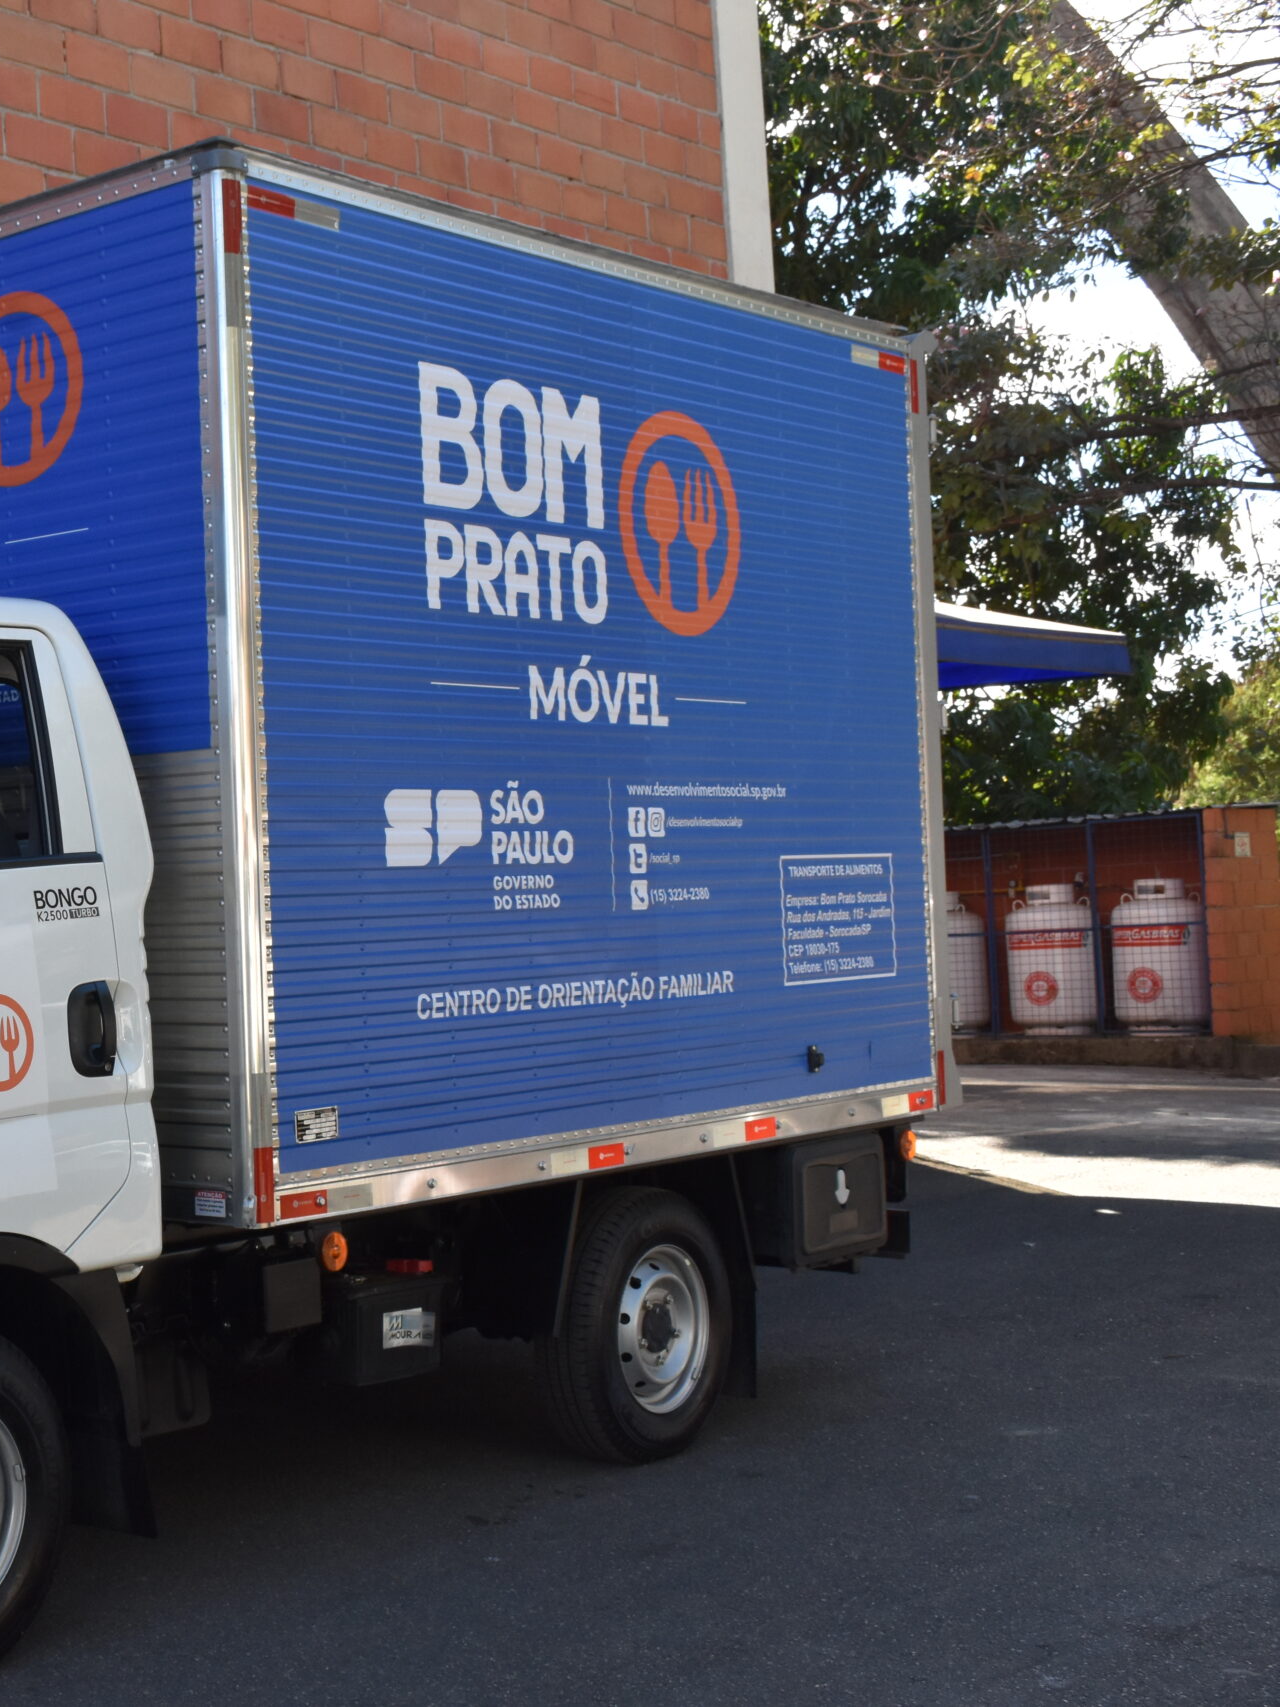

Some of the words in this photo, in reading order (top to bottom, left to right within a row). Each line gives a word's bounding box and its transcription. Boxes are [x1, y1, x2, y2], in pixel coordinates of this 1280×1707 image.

[418, 361, 604, 529] BOM
[424, 518, 608, 625] PRATO
[527, 654, 669, 727] MÓVEL
[626, 781, 787, 800] www.desenvolvimentosocial.sp.gov.br
[489, 780, 545, 826] SÃO
[491, 830, 574, 866] PAULO
[649, 852, 681, 865] /social_sp
[788, 865, 835, 878] TRANSPORTE
[835, 865, 845, 876] DE
[845, 864, 883, 875] ALIMENTOS
[492, 874, 554, 891] GOVERNO
[33, 886, 97, 910] BONGO
[494, 894, 512, 911] DO
[515, 893, 561, 910] ESTADO
[650, 888, 667, 904] (15)
[669, 888, 710, 901] 3224-2380
[786, 894, 819, 909] Empresa:
[820, 893, 837, 905] Bom
[838, 892, 856, 904] Prato
[37, 909, 69, 922] K2500
[70, 907, 98, 919] TURBO
[787, 911, 802, 923] Rua
[802, 910, 816, 922] dos
[788, 927, 824, 940] Faculdade
[788, 944, 804, 957] CEP
[788, 962, 823, 975] Telefone:
[824, 959, 839, 974] (15)
[416, 989, 502, 1020] CENTRO
[506, 986, 533, 1012] DE
[537, 972, 655, 1009] ORIENTAÇÃO
[658, 970, 734, 999] FAMILIAR
[388, 1330, 421, 1341] MOURA
